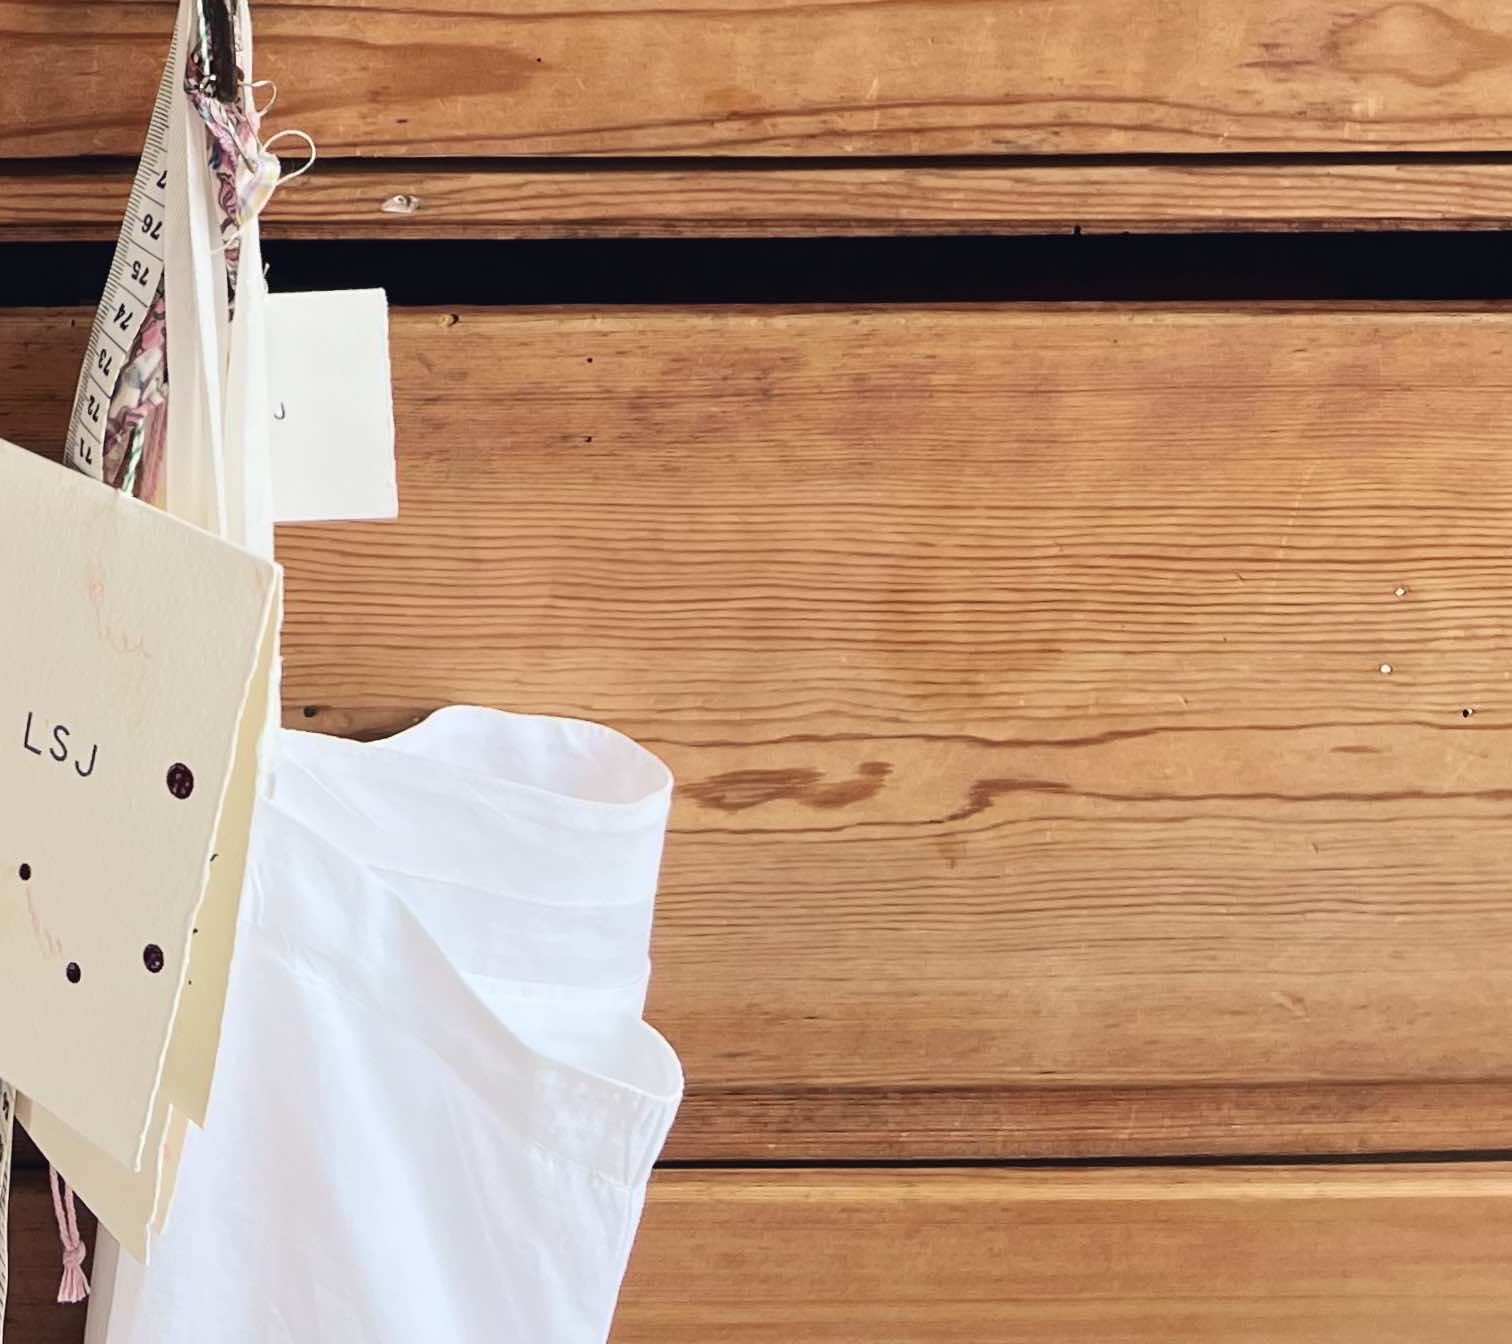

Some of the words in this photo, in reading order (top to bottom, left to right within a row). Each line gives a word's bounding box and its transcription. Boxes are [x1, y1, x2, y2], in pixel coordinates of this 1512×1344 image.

[141, 213, 163, 241] 76
[131, 260, 150, 287] 75
[113, 303, 133, 331] 74
[98, 348, 113, 377] 73
[87, 395, 101, 423] 72
[80, 437, 92, 465] 71
[23, 711, 99, 778] LSJ
